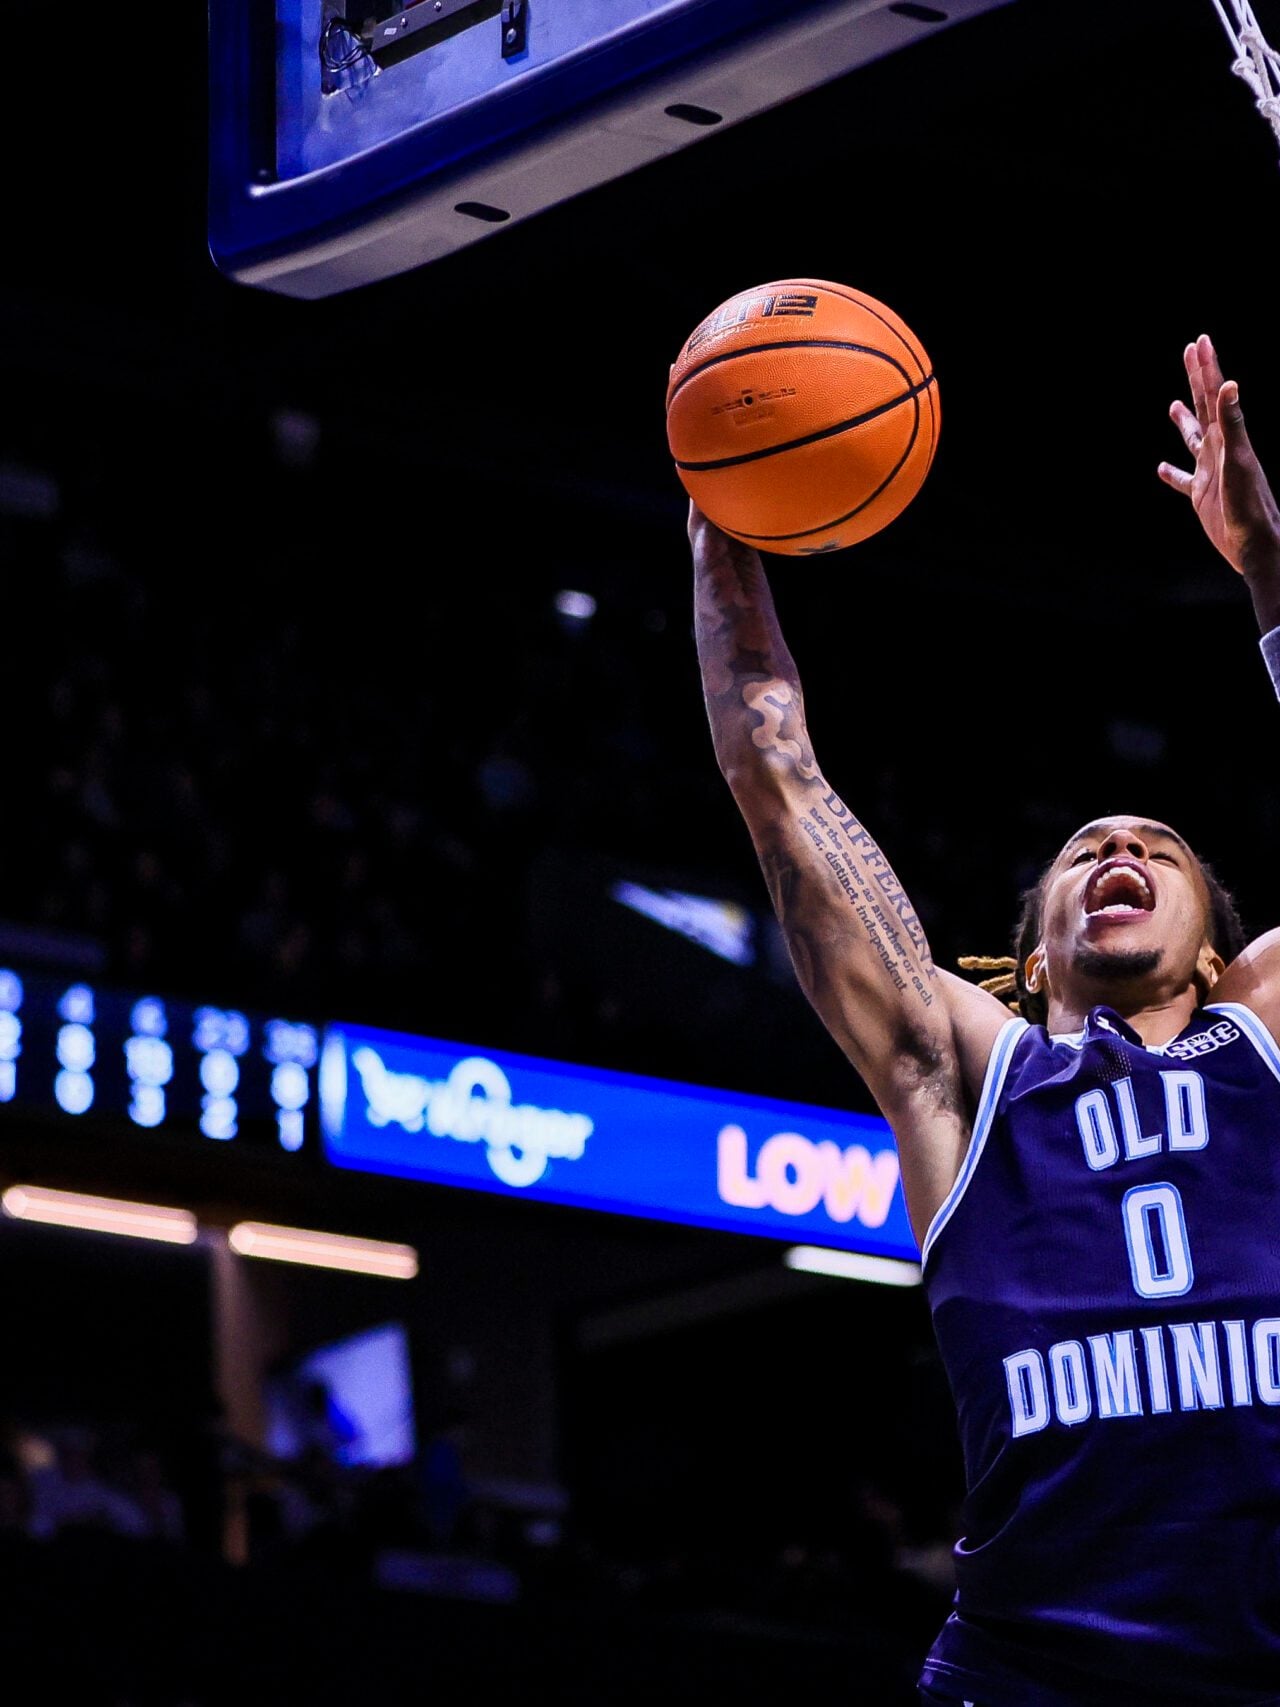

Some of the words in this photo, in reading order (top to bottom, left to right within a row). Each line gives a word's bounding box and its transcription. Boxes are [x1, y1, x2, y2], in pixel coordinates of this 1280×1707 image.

[809, 807, 827, 829] not
[826, 827, 843, 850] the
[841, 850, 864, 886] same
[862, 888, 875, 902] as
[871, 903, 906, 958] another
[903, 957, 915, 973] or
[911, 975, 933, 1007] each
[823, 791, 938, 980] DIFFERENT
[825, 851, 856, 905] distinct,
[856, 904, 906, 992] independent
[1165, 1021, 1240, 1060] SBC
[717, 1124, 900, 1228] LOW
[1075, 1070, 1209, 1171] OLD
[1122, 1181, 1194, 1298] 0
